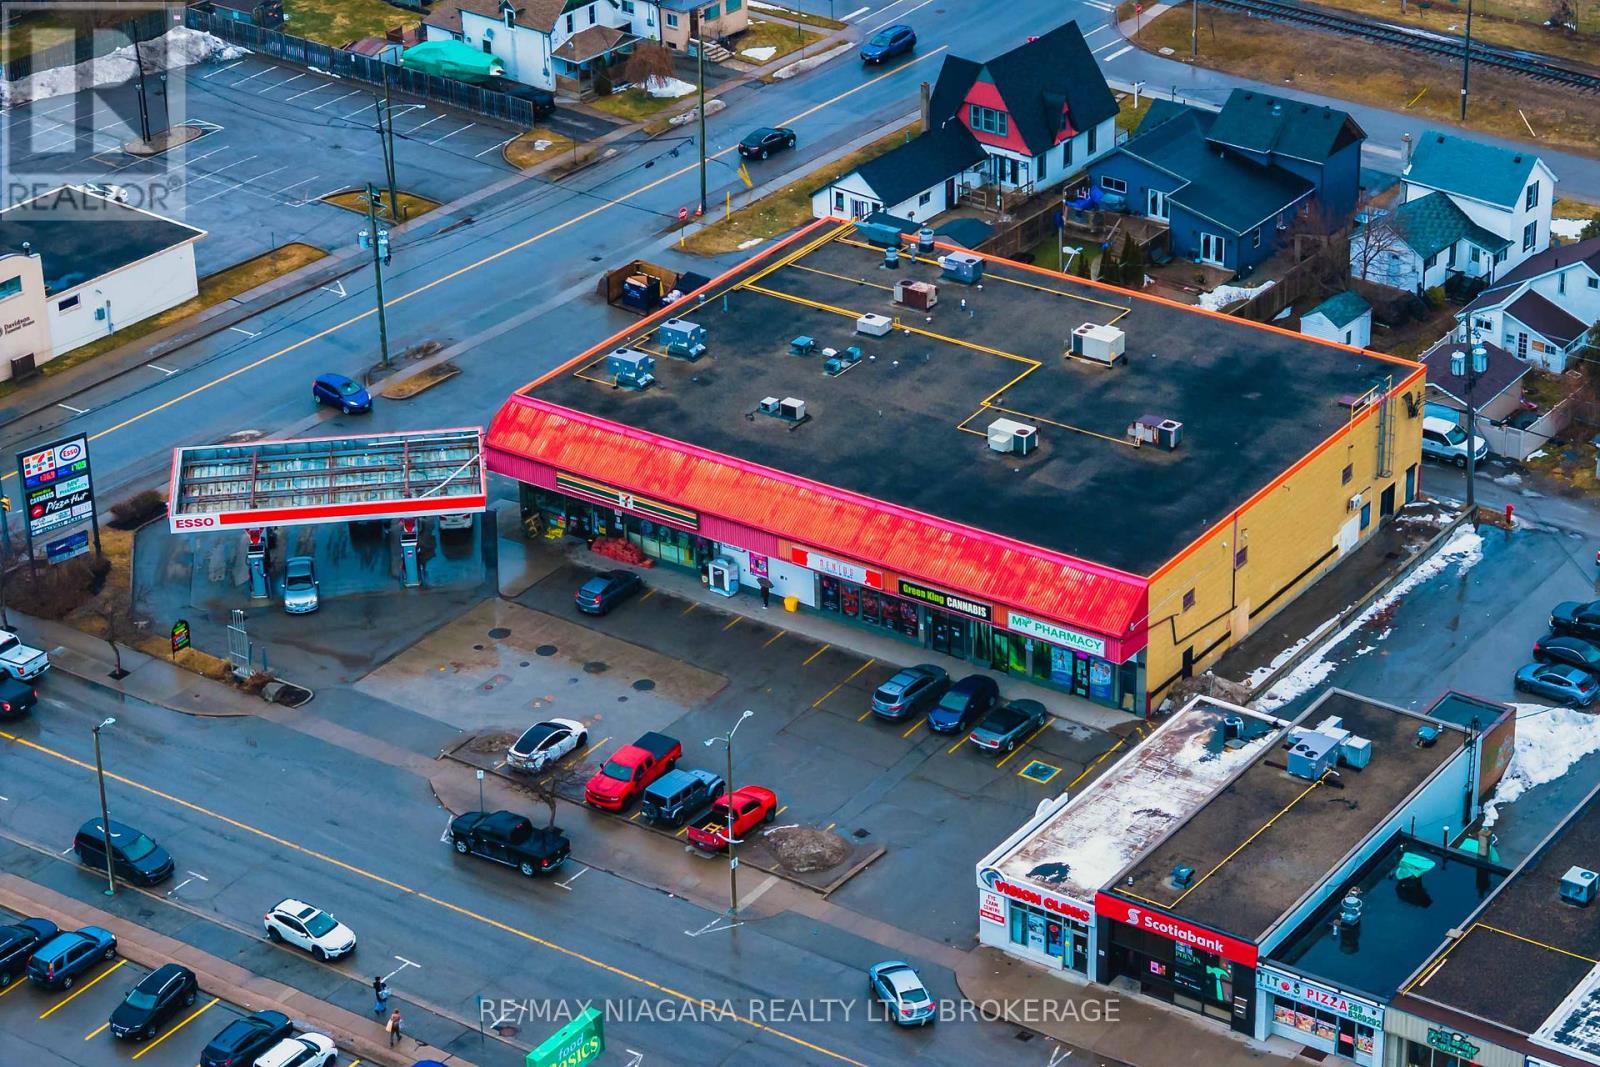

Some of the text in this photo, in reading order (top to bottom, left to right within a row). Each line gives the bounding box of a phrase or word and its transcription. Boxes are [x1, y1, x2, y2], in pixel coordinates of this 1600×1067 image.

[4, 316, 31, 330] Davidson
[63, 448, 78, 458] Esso
[45, 499, 71, 514] Pizza
[71, 492, 88, 504] Hut
[175, 517, 214, 529] ESSO
[902, 583, 987, 618] Green King CANNABIS
[1034, 622, 1102, 651] PHARMACY
[995, 880, 1090, 922] VISION CLINIC
[1144, 916, 1224, 953] Scotiabank
[1306, 988, 1348, 1012] PIZZA
[559, 1032, 584, 1061] food
